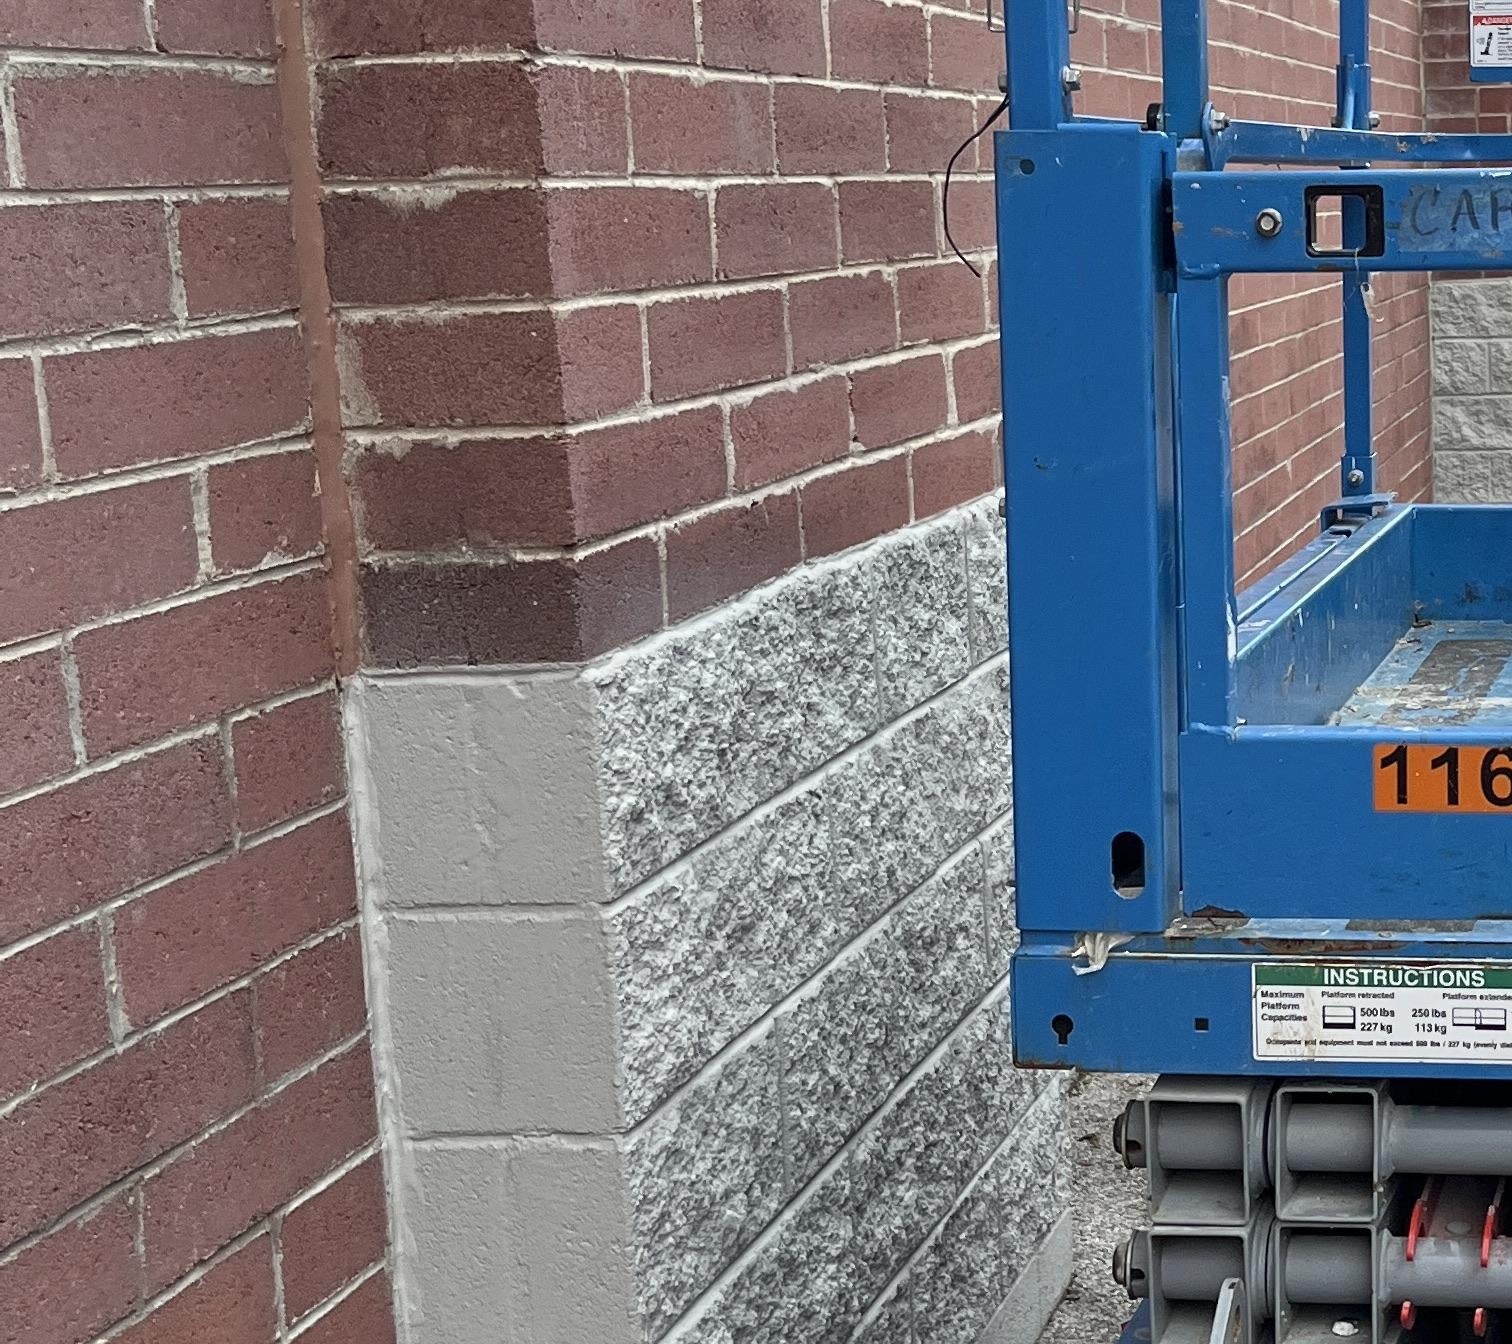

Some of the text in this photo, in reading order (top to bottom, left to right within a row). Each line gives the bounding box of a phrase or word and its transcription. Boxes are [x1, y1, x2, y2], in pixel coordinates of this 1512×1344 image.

[1323, 968, 1485, 987] INSTRUCTIONS
[1360, 1008, 1395, 1017] 500 lbs
[1411, 1009, 1446, 1017] 250 lbs
[1261, 1014, 1307, 1022] Capacities
[1360, 1023, 1392, 1034] 227 kg
[1415, 1024, 1447, 1034] 113 kg
